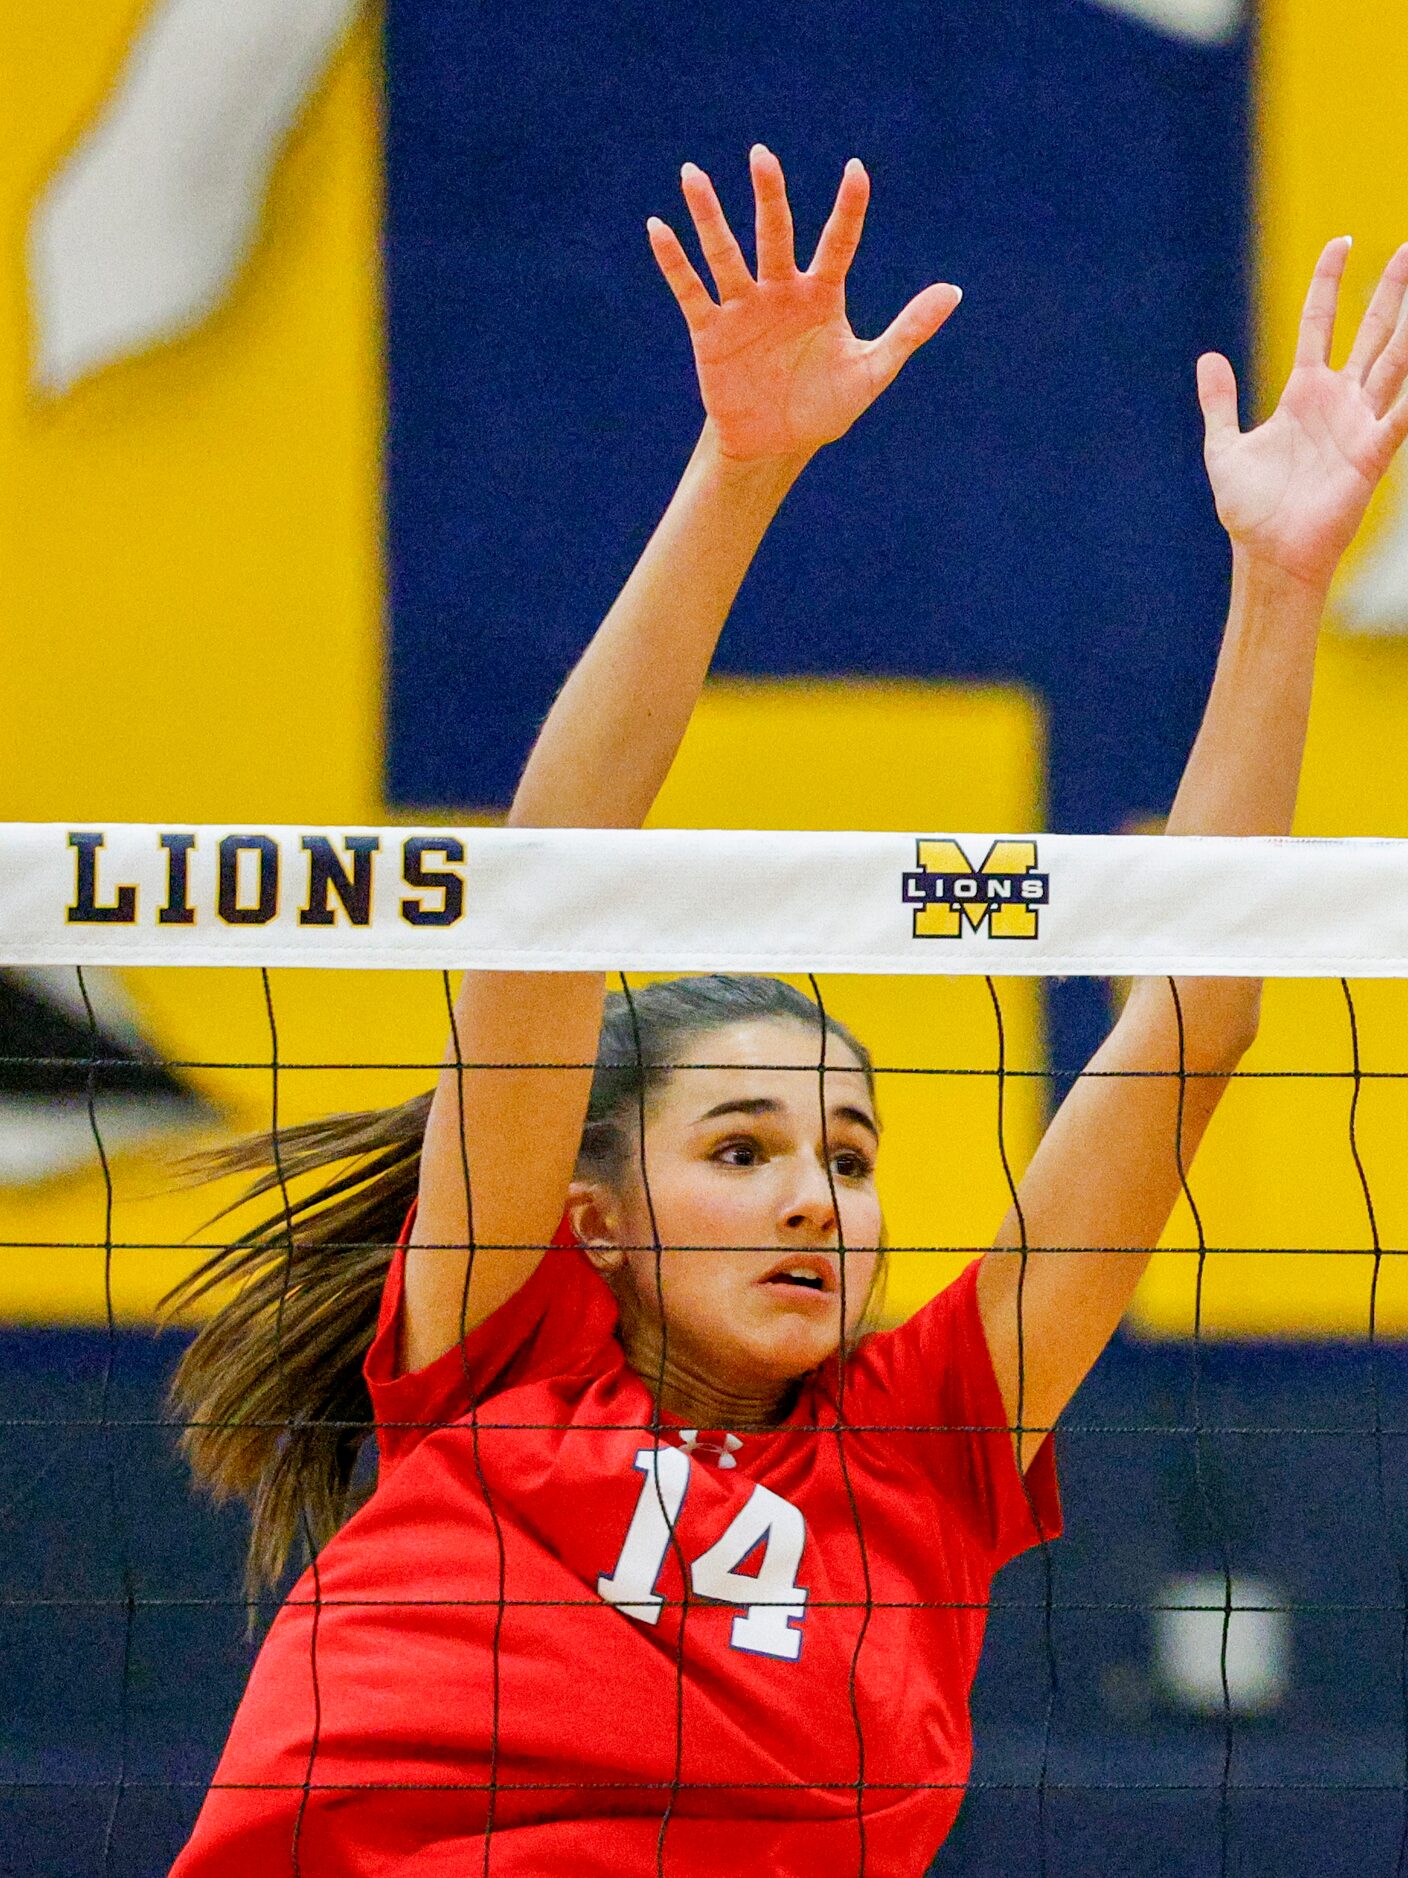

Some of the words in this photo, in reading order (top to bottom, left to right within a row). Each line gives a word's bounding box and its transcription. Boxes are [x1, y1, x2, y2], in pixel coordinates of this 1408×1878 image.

[66, 832, 467, 928] LIONS
[907, 878, 1044, 899] LIONS
[912, 838, 1038, 940] M
[597, 1446, 808, 1663] 14
